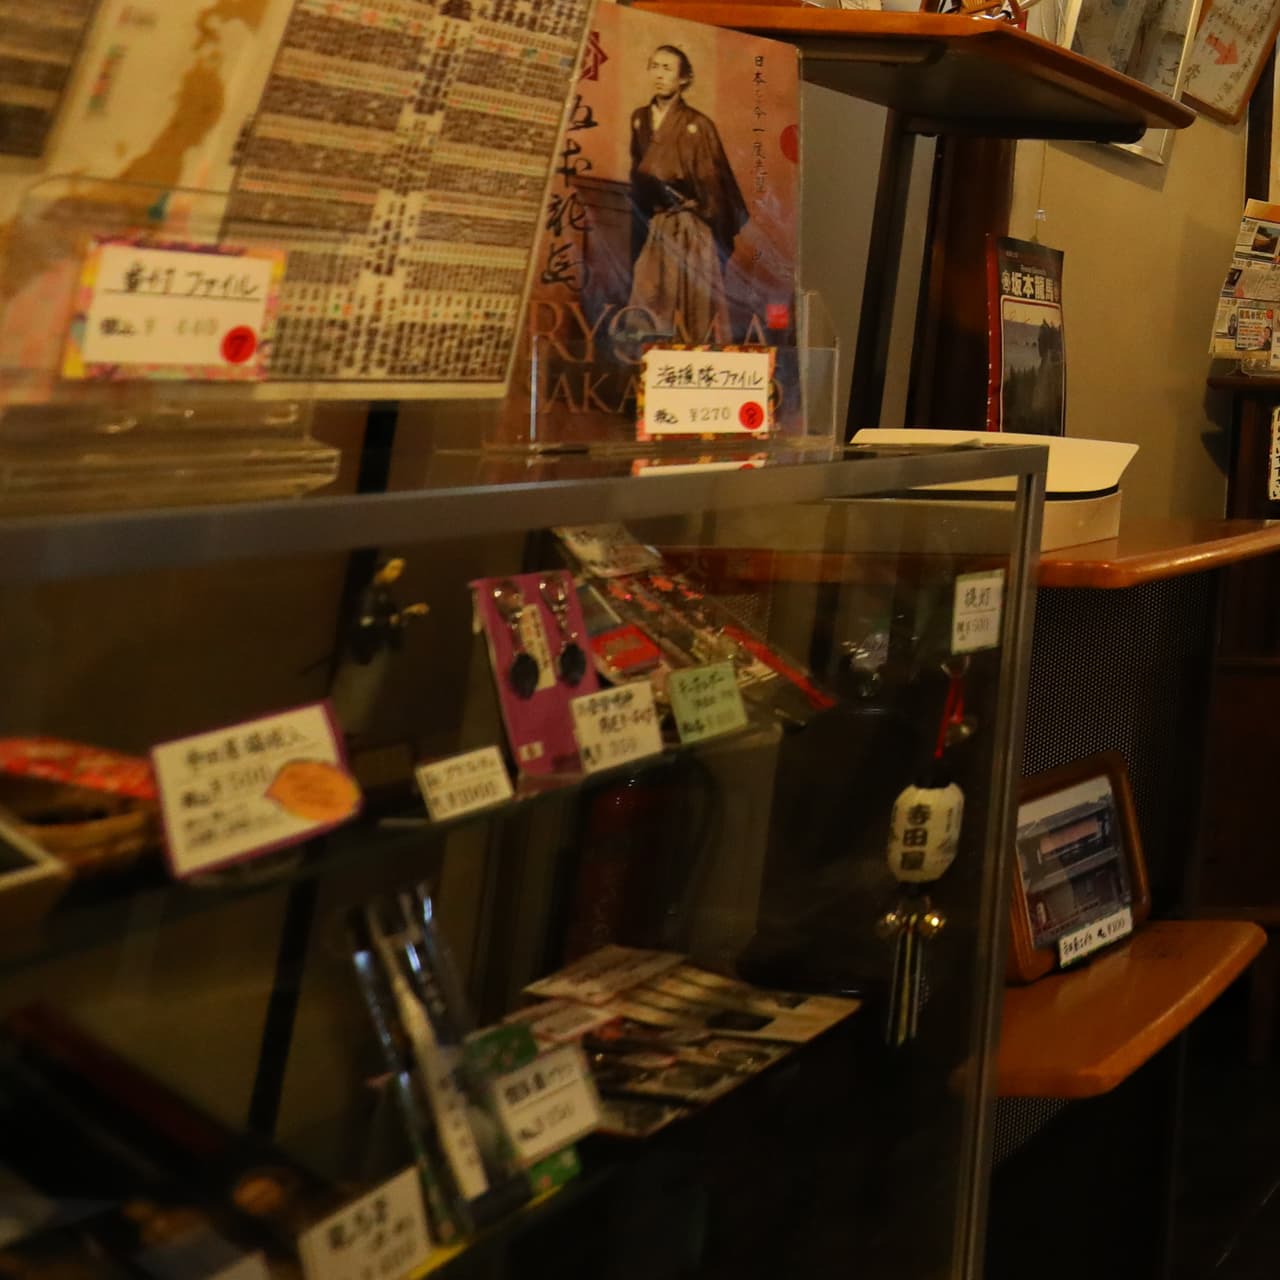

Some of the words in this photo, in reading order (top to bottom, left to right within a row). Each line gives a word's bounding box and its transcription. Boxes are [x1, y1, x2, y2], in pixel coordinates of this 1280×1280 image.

[125, 268, 259, 296] 番付ファイル
[657, 363, 763, 388] 海援隊ファイル
[689, 407, 731, 422] ¥270
